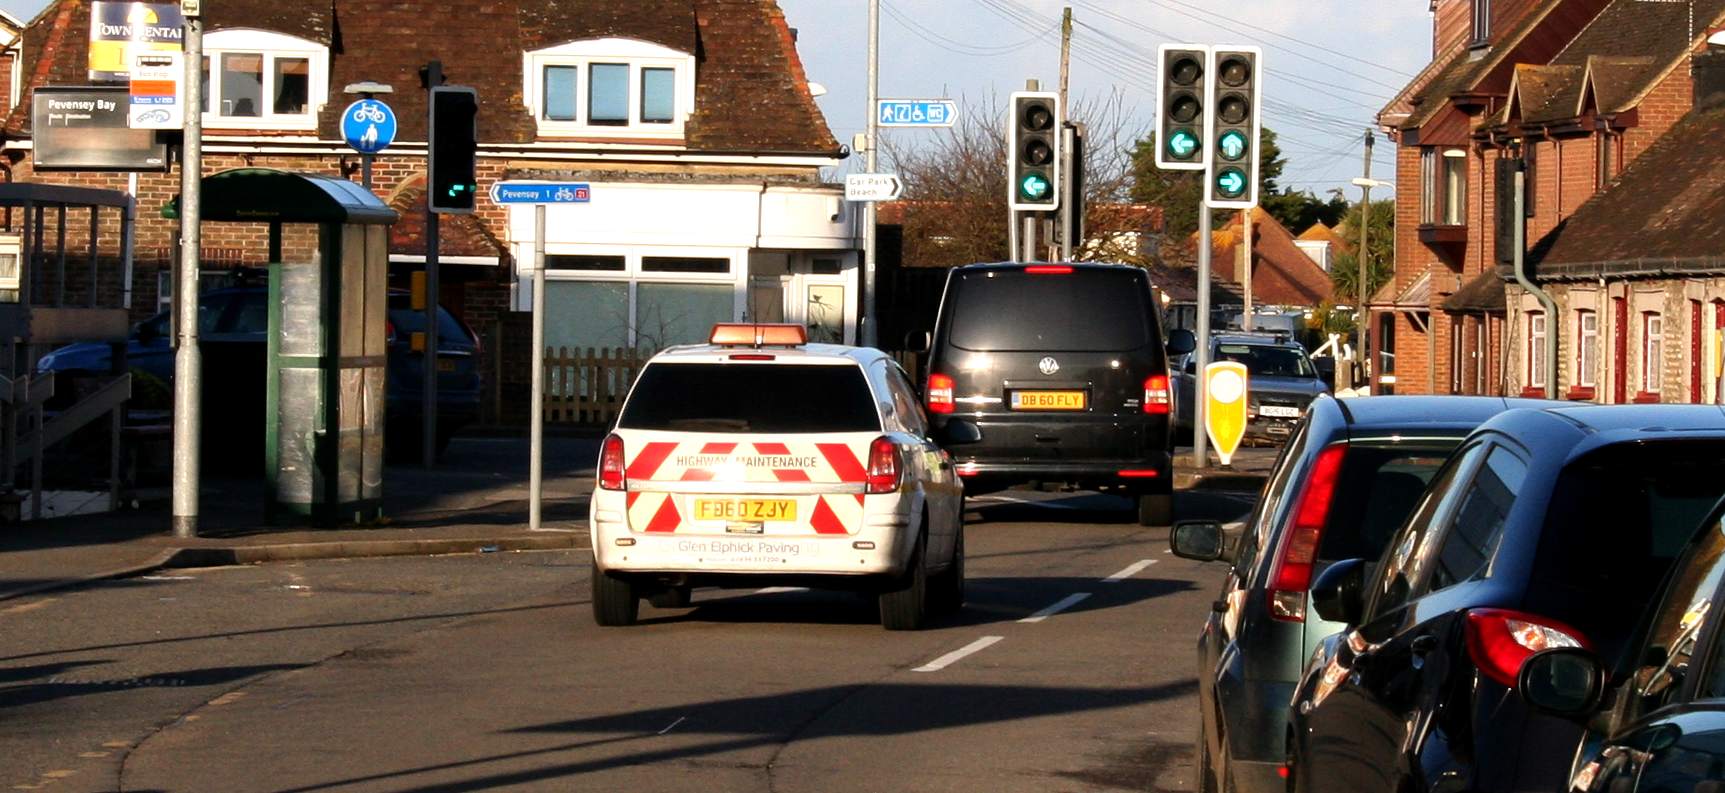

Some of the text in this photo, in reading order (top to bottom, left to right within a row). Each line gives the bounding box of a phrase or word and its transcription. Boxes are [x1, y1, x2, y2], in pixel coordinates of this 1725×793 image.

[48, 99, 117, 112] Pevensey Bay
[928, 109, 942, 118] WC
[849, 177, 888, 185] Car Park
[502, 189, 539, 200] Pevensey
[850, 188, 877, 196] Beach
[1057, 395, 1079, 406] FLY
[676, 456, 817, 468] HIGHWAY MAINTENANCE
[754, 501, 788, 518] ZJY
[678, 540, 800, 556] Glen Elphick Paving
